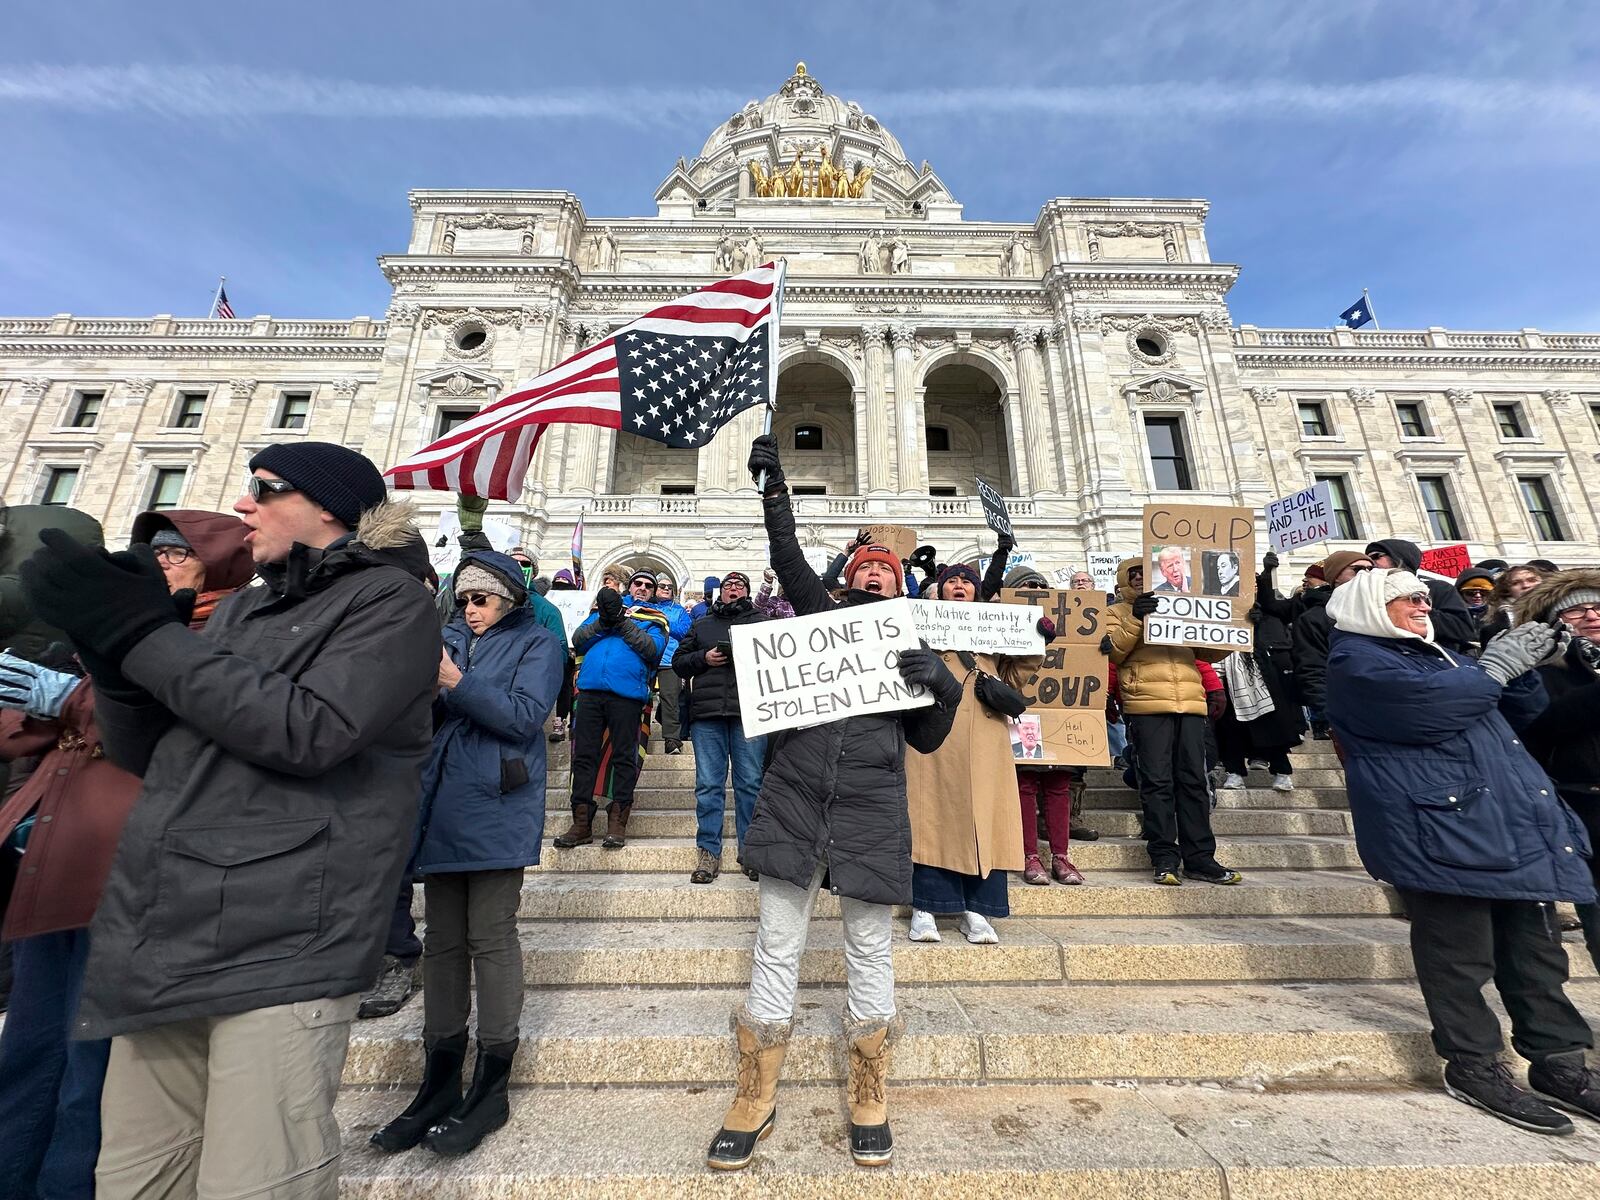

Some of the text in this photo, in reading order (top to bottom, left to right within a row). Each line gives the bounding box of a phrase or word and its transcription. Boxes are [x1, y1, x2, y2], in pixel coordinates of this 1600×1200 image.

[1270, 487, 1316, 518] F'ELON
[1268, 501, 1327, 535] AND THE
[1280, 520, 1329, 548] FELON
[980, 553, 1033, 571] FDOM
[911, 604, 929, 623] My
[935, 605, 971, 621] Native
[1155, 596, 1231, 621] CONS
[752, 617, 901, 665] NO ONE IS
[915, 622, 951, 637] zenship
[977, 624, 993, 632] not
[996, 627, 1006, 637] up
[925, 634, 1033, 649] bate! Navajo Nation
[1148, 619, 1250, 645] pirators
[1042, 647, 1067, 670] a
[756, 649, 907, 697] ILLEGAL O
[756, 680, 926, 722] STOLEN LAND
[1024, 674, 1101, 707] COUP
